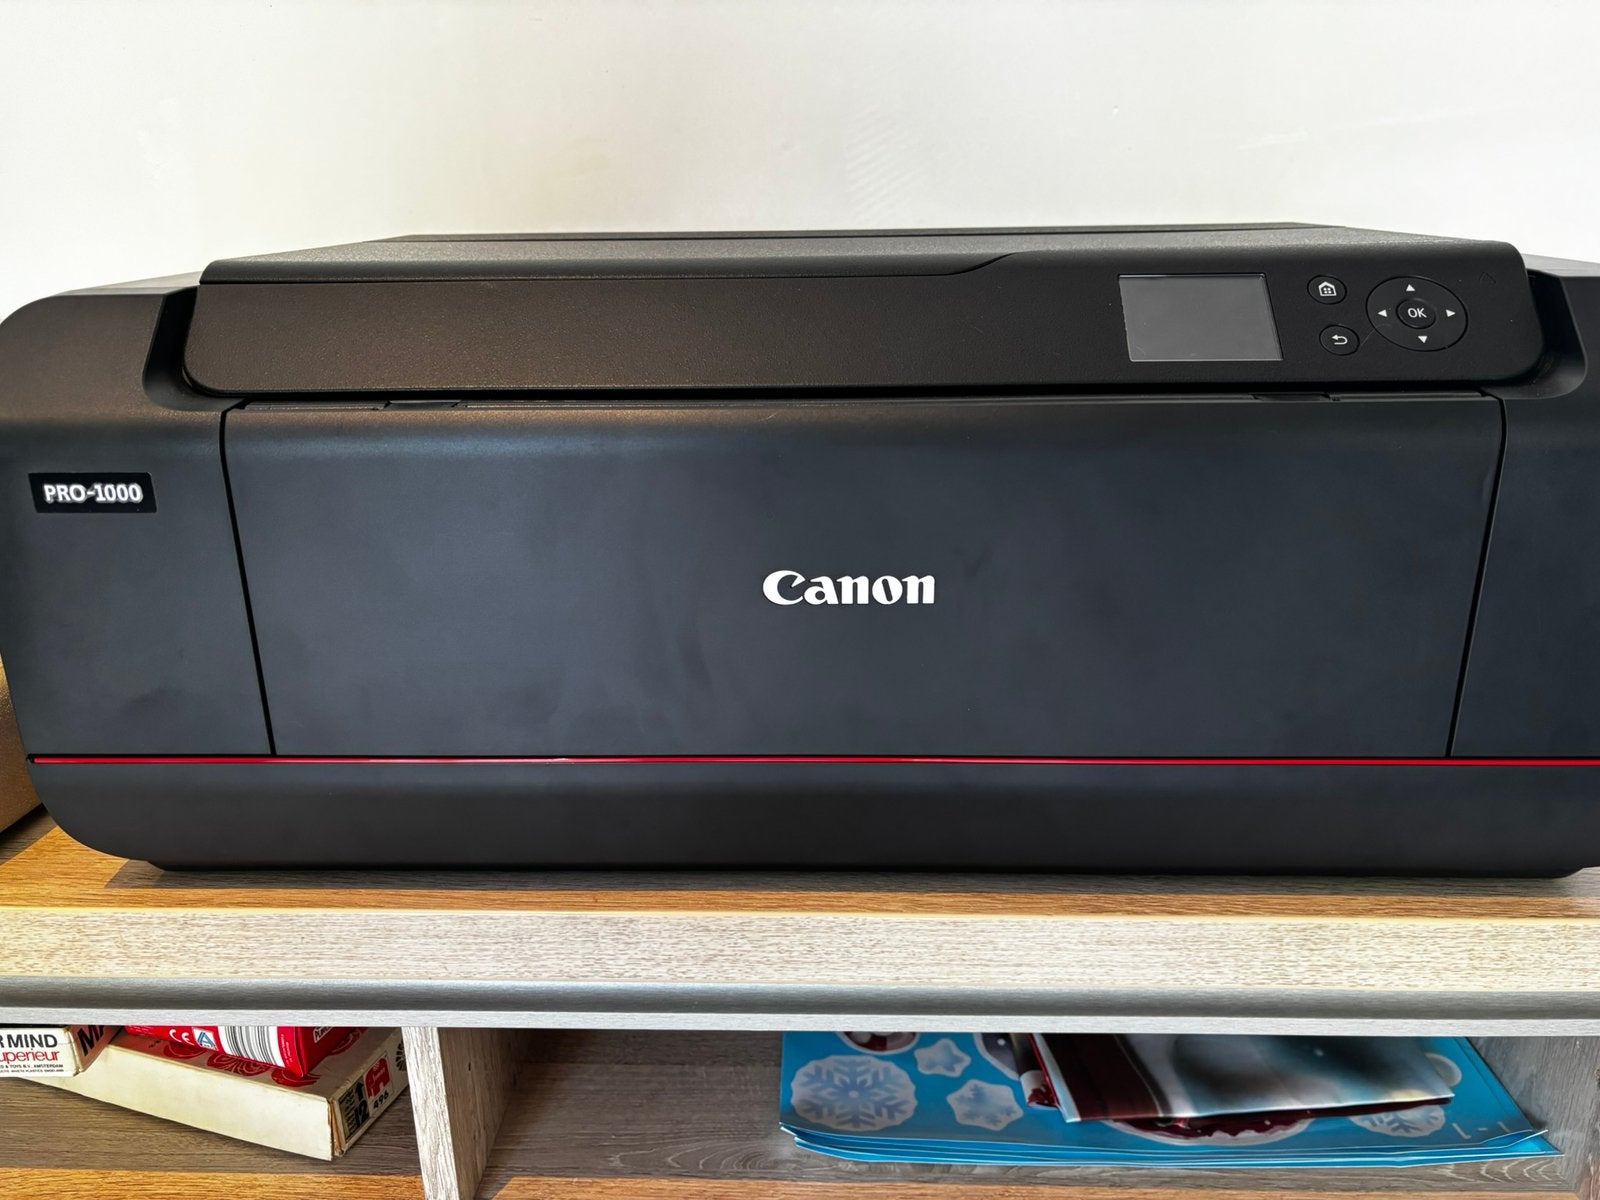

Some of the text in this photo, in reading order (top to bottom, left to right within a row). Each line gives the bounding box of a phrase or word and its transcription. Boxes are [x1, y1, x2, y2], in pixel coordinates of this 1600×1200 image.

[1407, 307, 1427, 318] OK
[44, 482, 143, 503] PRO-1000
[763, 570, 935, 606] Canon
[7, 1034, 58, 1048] MIND
[373, 1091, 389, 1109] 496
